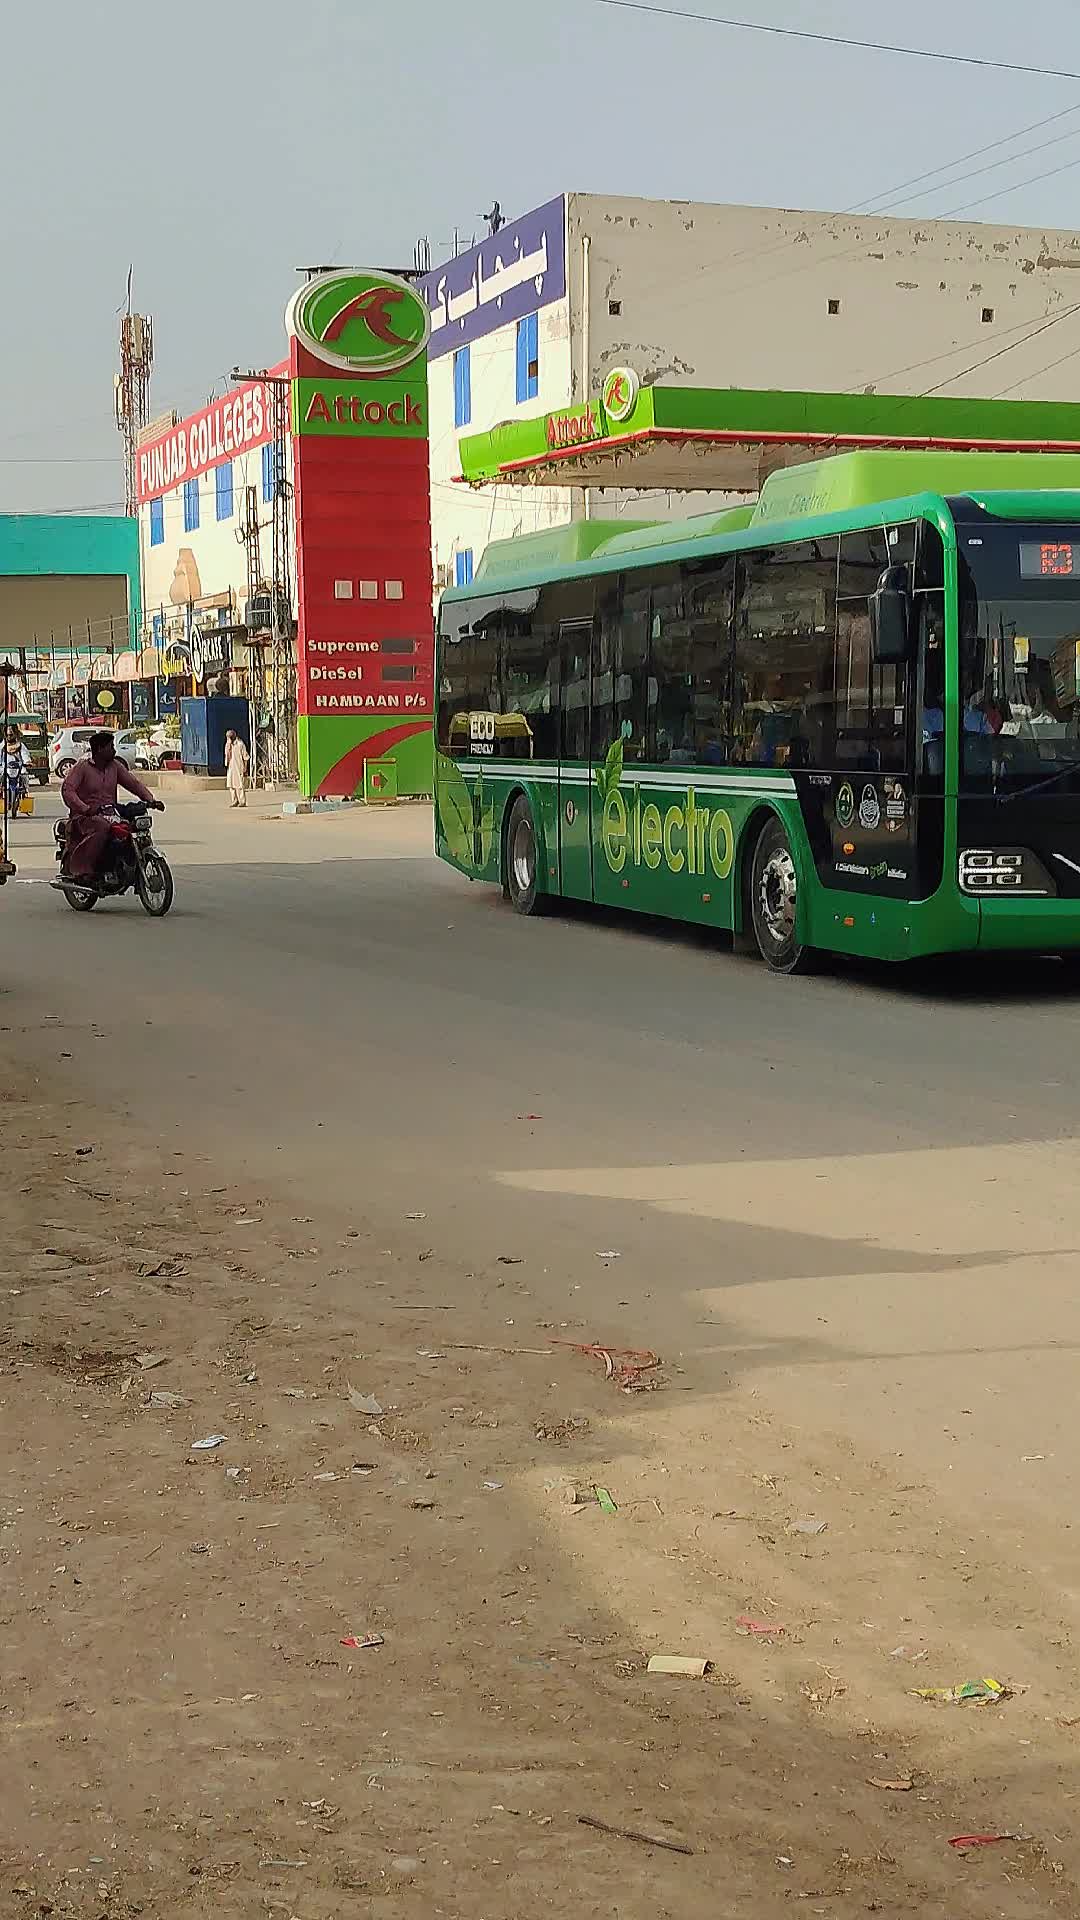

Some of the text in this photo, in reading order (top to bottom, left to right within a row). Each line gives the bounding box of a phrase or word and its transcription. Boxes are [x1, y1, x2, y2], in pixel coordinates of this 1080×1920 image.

[447, 231, 548, 331] پنجاب
[305, 392, 422, 425] Attock
[548, 403, 597, 443] Attock
[140, 430, 187, 496] PUNJAB
[189, 384, 264, 470] COLLEGES
[308, 640, 380, 655] Supreme
[316, 695, 400, 707] HAMDAAN
[470, 713, 494, 740] ECO
[602, 781, 734, 879] electro
